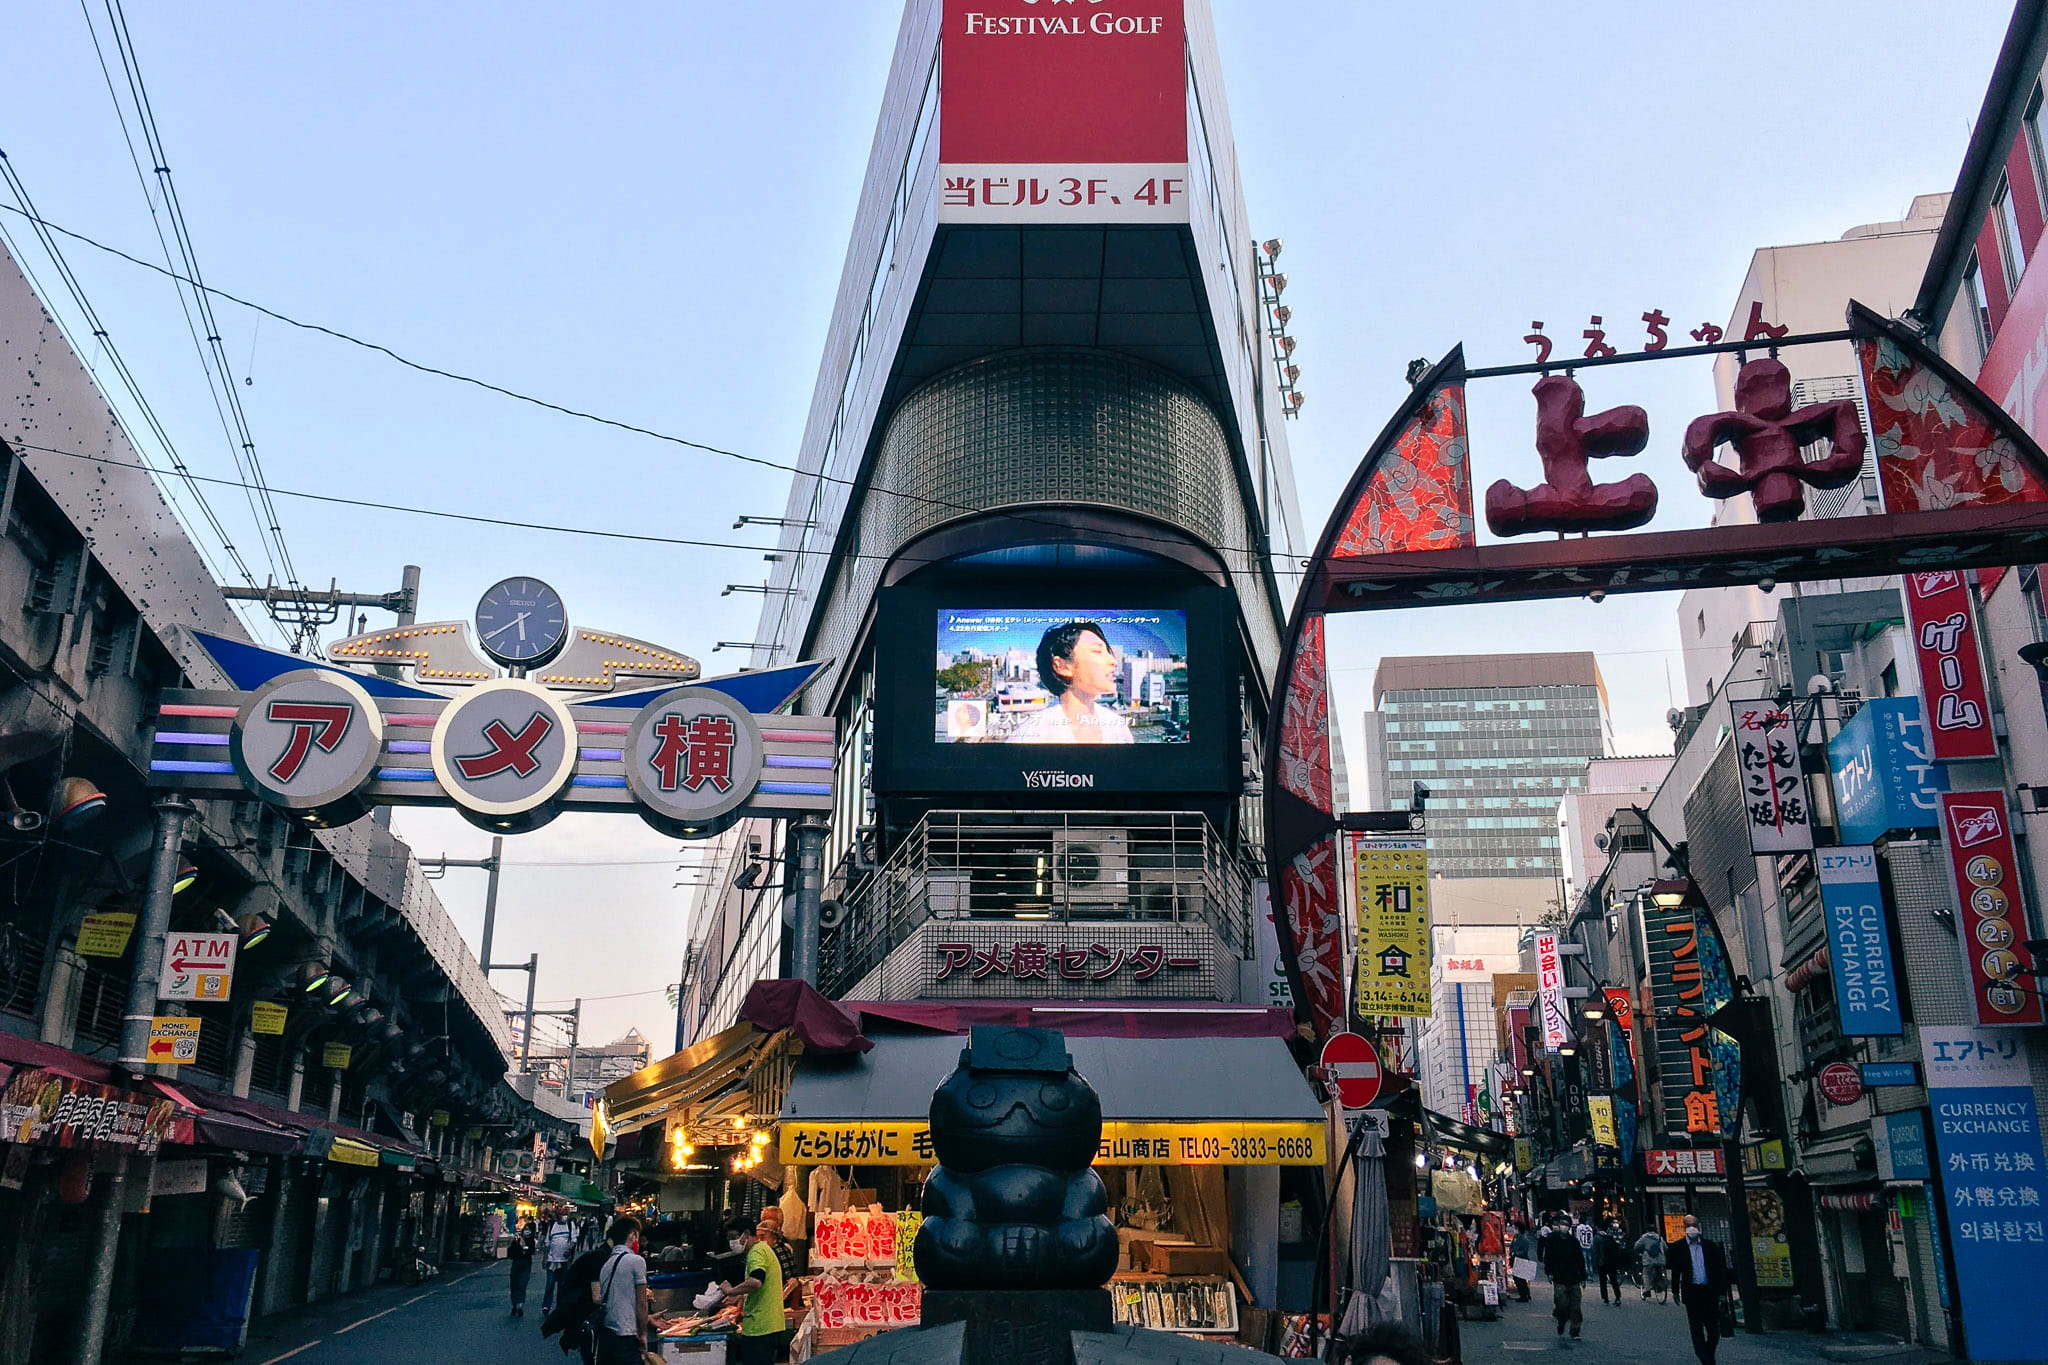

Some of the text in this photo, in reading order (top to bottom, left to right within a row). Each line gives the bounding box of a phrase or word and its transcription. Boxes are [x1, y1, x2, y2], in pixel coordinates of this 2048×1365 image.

[964, 12, 1163, 35] FESTIVAL GOLF
[1523, 301, 1788, 364] うえちゅん
[1485, 356, 1867, 538] 上中
[1920, 613, 1982, 730] ゲーム
[268, 702, 737, 793] アメ横
[1741, 742, 1778, 828] たこ焼
[1822, 855, 1872, 869] エアトリ
[1972, 863, 1997, 881] 4F
[1977, 893, 2002, 912] 3F
[1983, 924, 2008, 943] 2F
[172, 940, 229, 957] ATM
[1834, 906, 1867, 1012] EXCHANGE
[1859, 904, 1891, 1012] CURRENCY
[937, 941, 1201, 980] アメ横センター
[1540, 937, 1560, 1032] 出会いカフェ
[1933, 1040, 2018, 1061] エアトリ
[1940, 1103, 2028, 1117] CURRENCY
[1943, 1120, 2031, 1134] EXCHANGE
[793, 1130, 898, 1159] たらばがに
[1179, 1136, 1313, 1160] TEL03-3833-6668
[1656, 1151, 1717, 1174] 大黒屋
[1960, 1221, 2045, 1243] 외화환전
